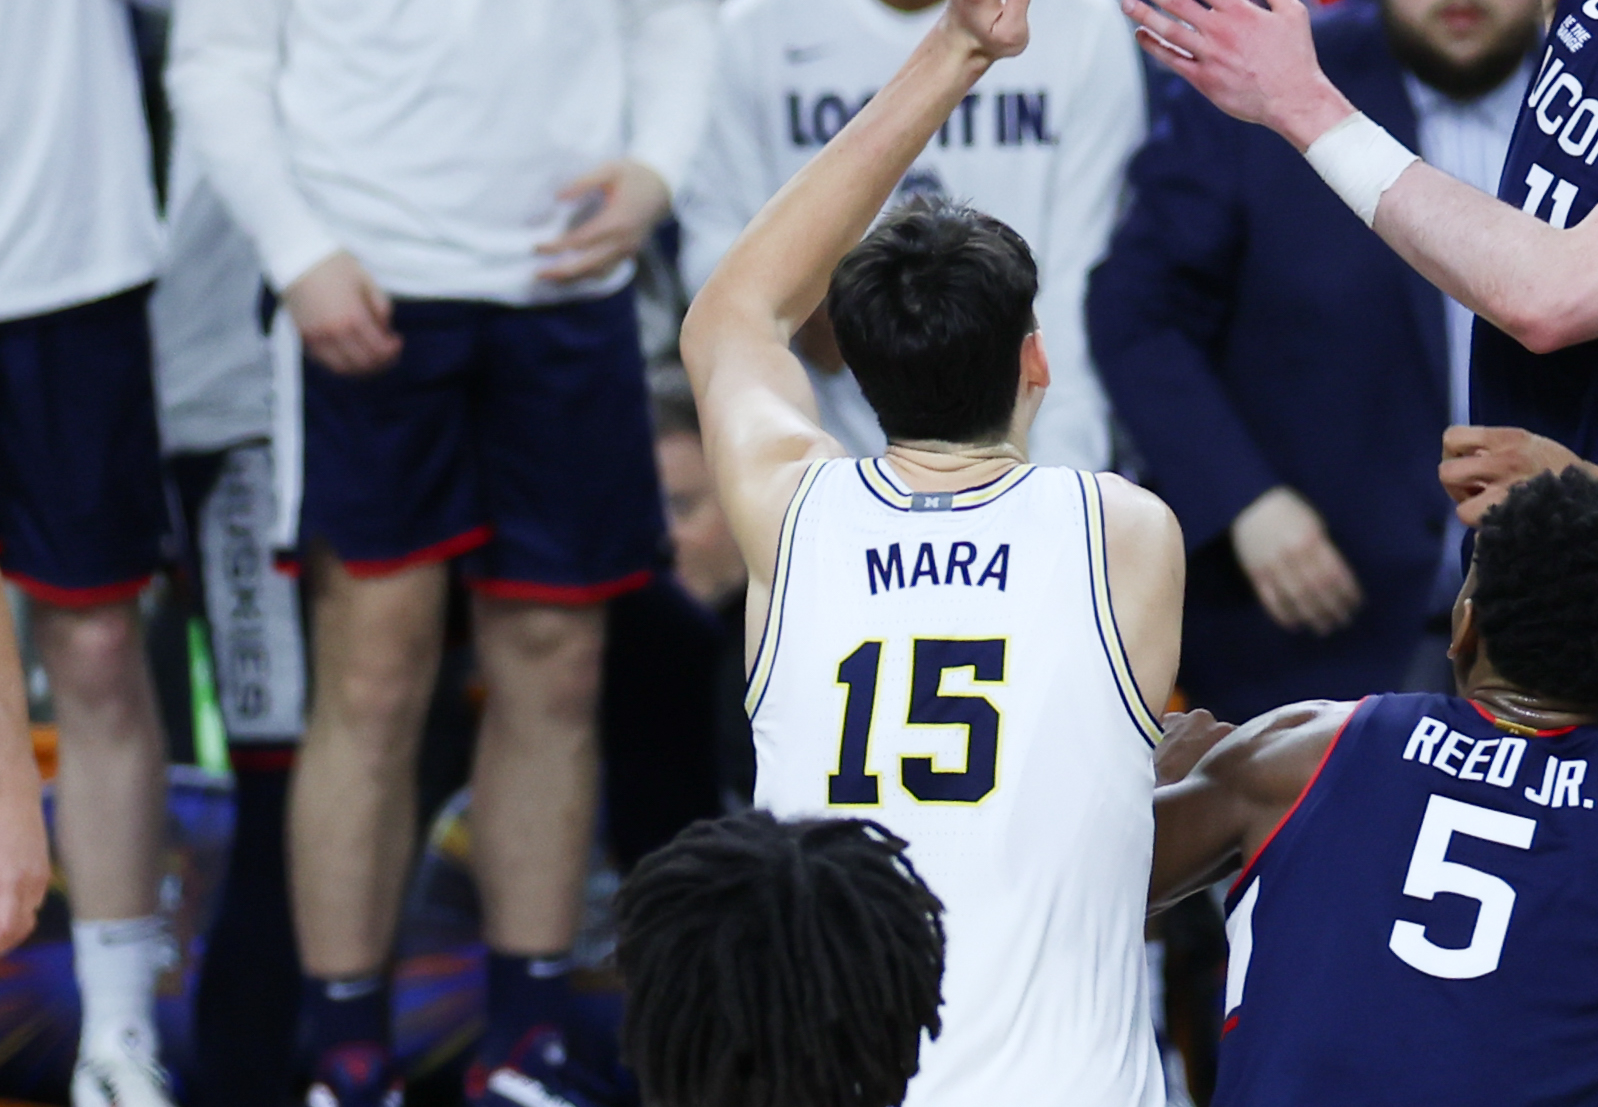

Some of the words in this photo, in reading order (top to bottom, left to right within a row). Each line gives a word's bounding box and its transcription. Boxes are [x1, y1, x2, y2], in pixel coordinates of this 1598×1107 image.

[1570, 22, 1592, 44] THE
[1524, 162, 1580, 230] 11
[866, 541, 1010, 595] MARA
[826, 635, 1010, 808] 15
[1402, 715, 1528, 788] REED
[1524, 754, 1594, 809] JR.
[1388, 793, 1537, 981] 5
